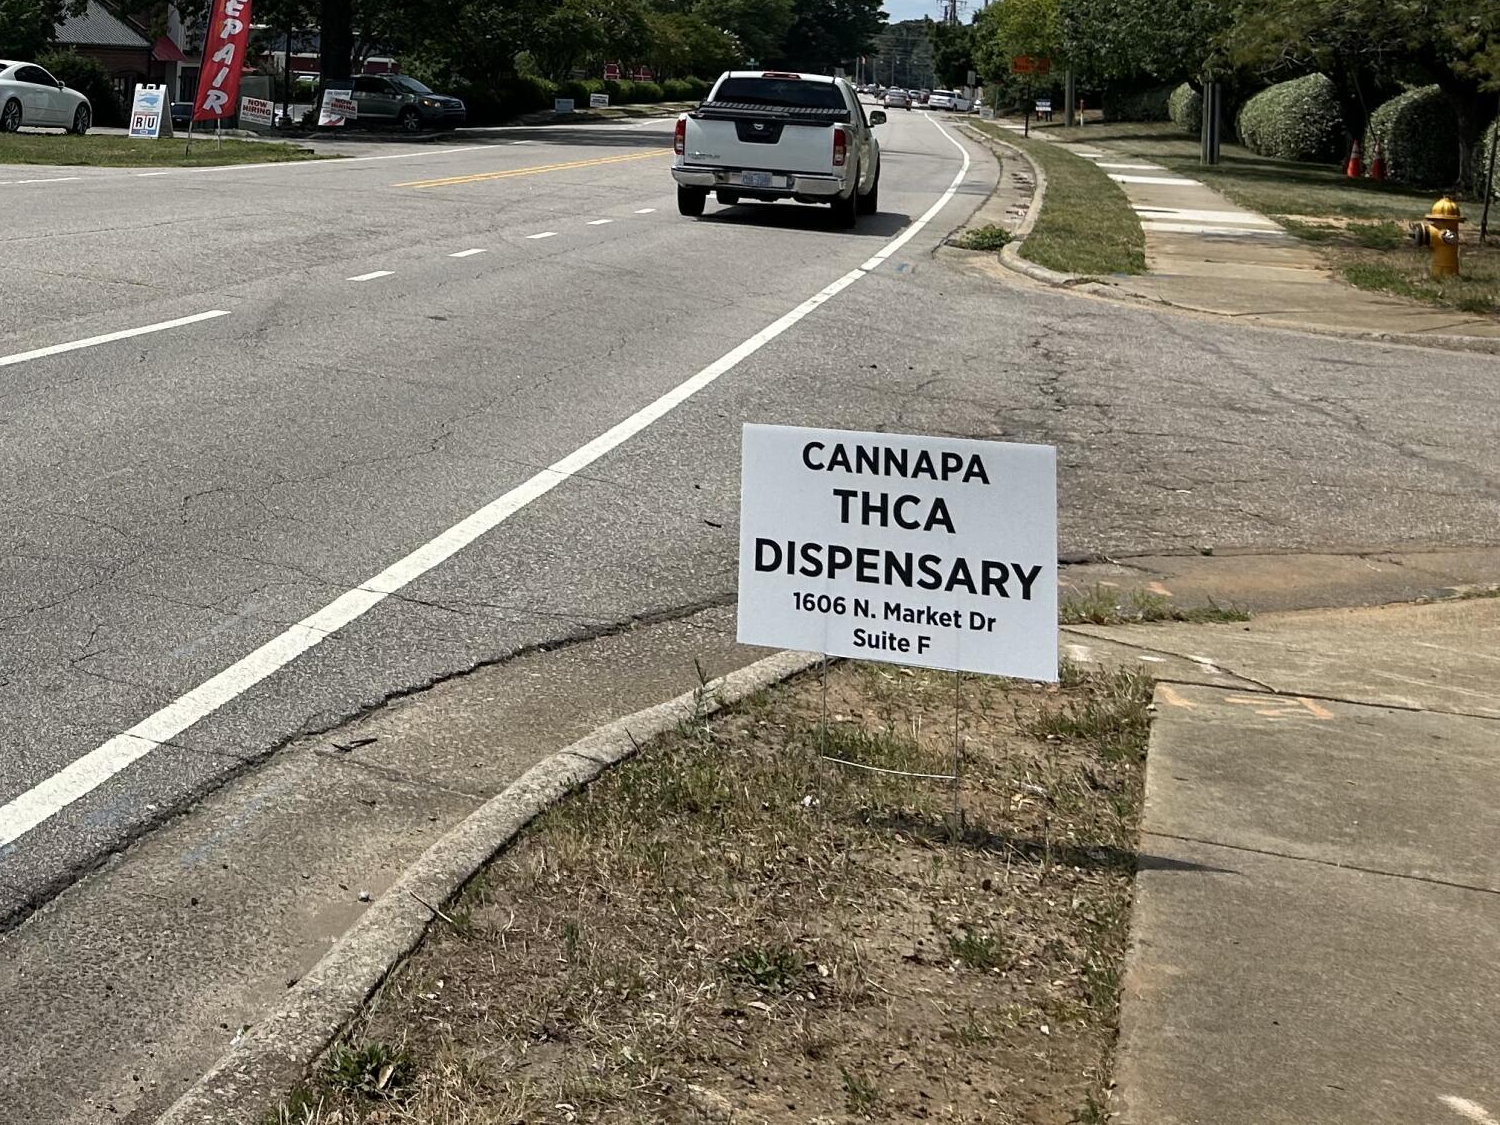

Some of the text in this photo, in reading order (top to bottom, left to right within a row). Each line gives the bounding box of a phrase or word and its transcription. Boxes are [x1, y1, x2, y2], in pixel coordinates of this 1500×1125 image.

[242, 105, 271, 116] HIRING
[248, 98, 268, 108] NOW
[802, 441, 991, 485] CANNAPA
[833, 488, 956, 534] THCA
[754, 537, 1042, 601] DISPENSARY
[793, 591, 996, 632] 1606 N. Market Dr
[852, 628, 931, 655] Suite F
